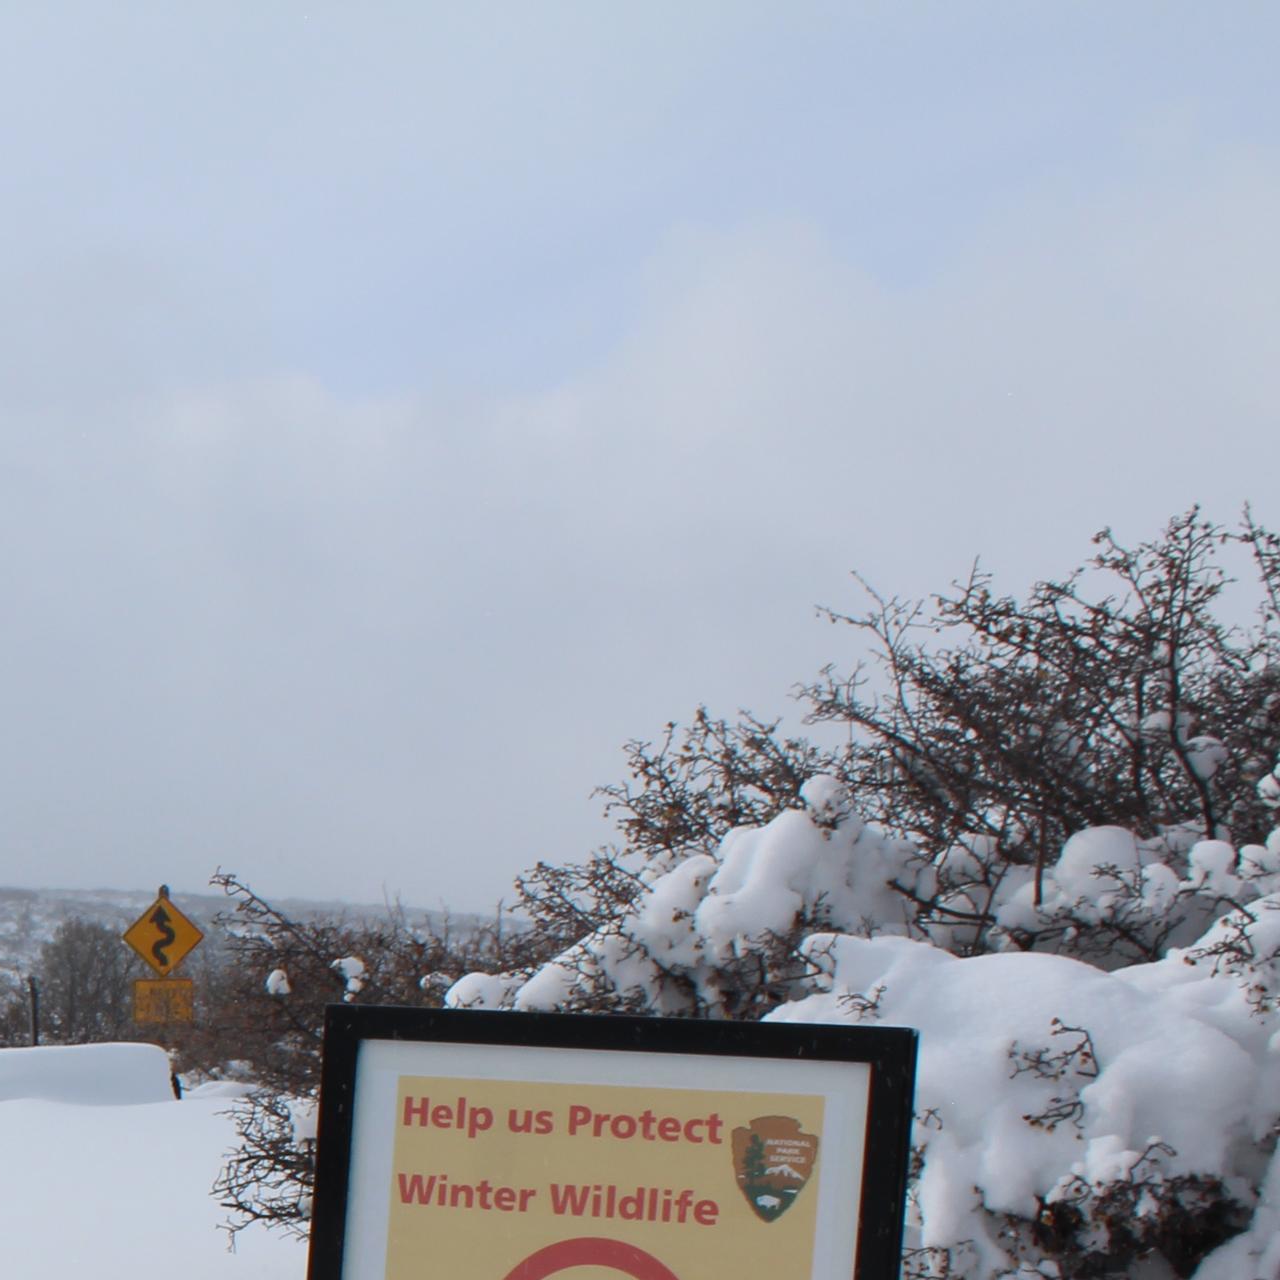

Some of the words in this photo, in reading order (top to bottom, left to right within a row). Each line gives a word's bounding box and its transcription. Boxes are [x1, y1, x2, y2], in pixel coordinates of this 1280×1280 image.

[402, 1096, 494, 1139] Help
[507, 1108, 554, 1135] us
[567, 1105, 724, 1145] Protect
[766, 1139, 811, 1148] NATIONAL
[397, 1173, 537, 1213] Winter
[549, 1183, 720, 1226] Wildlife
